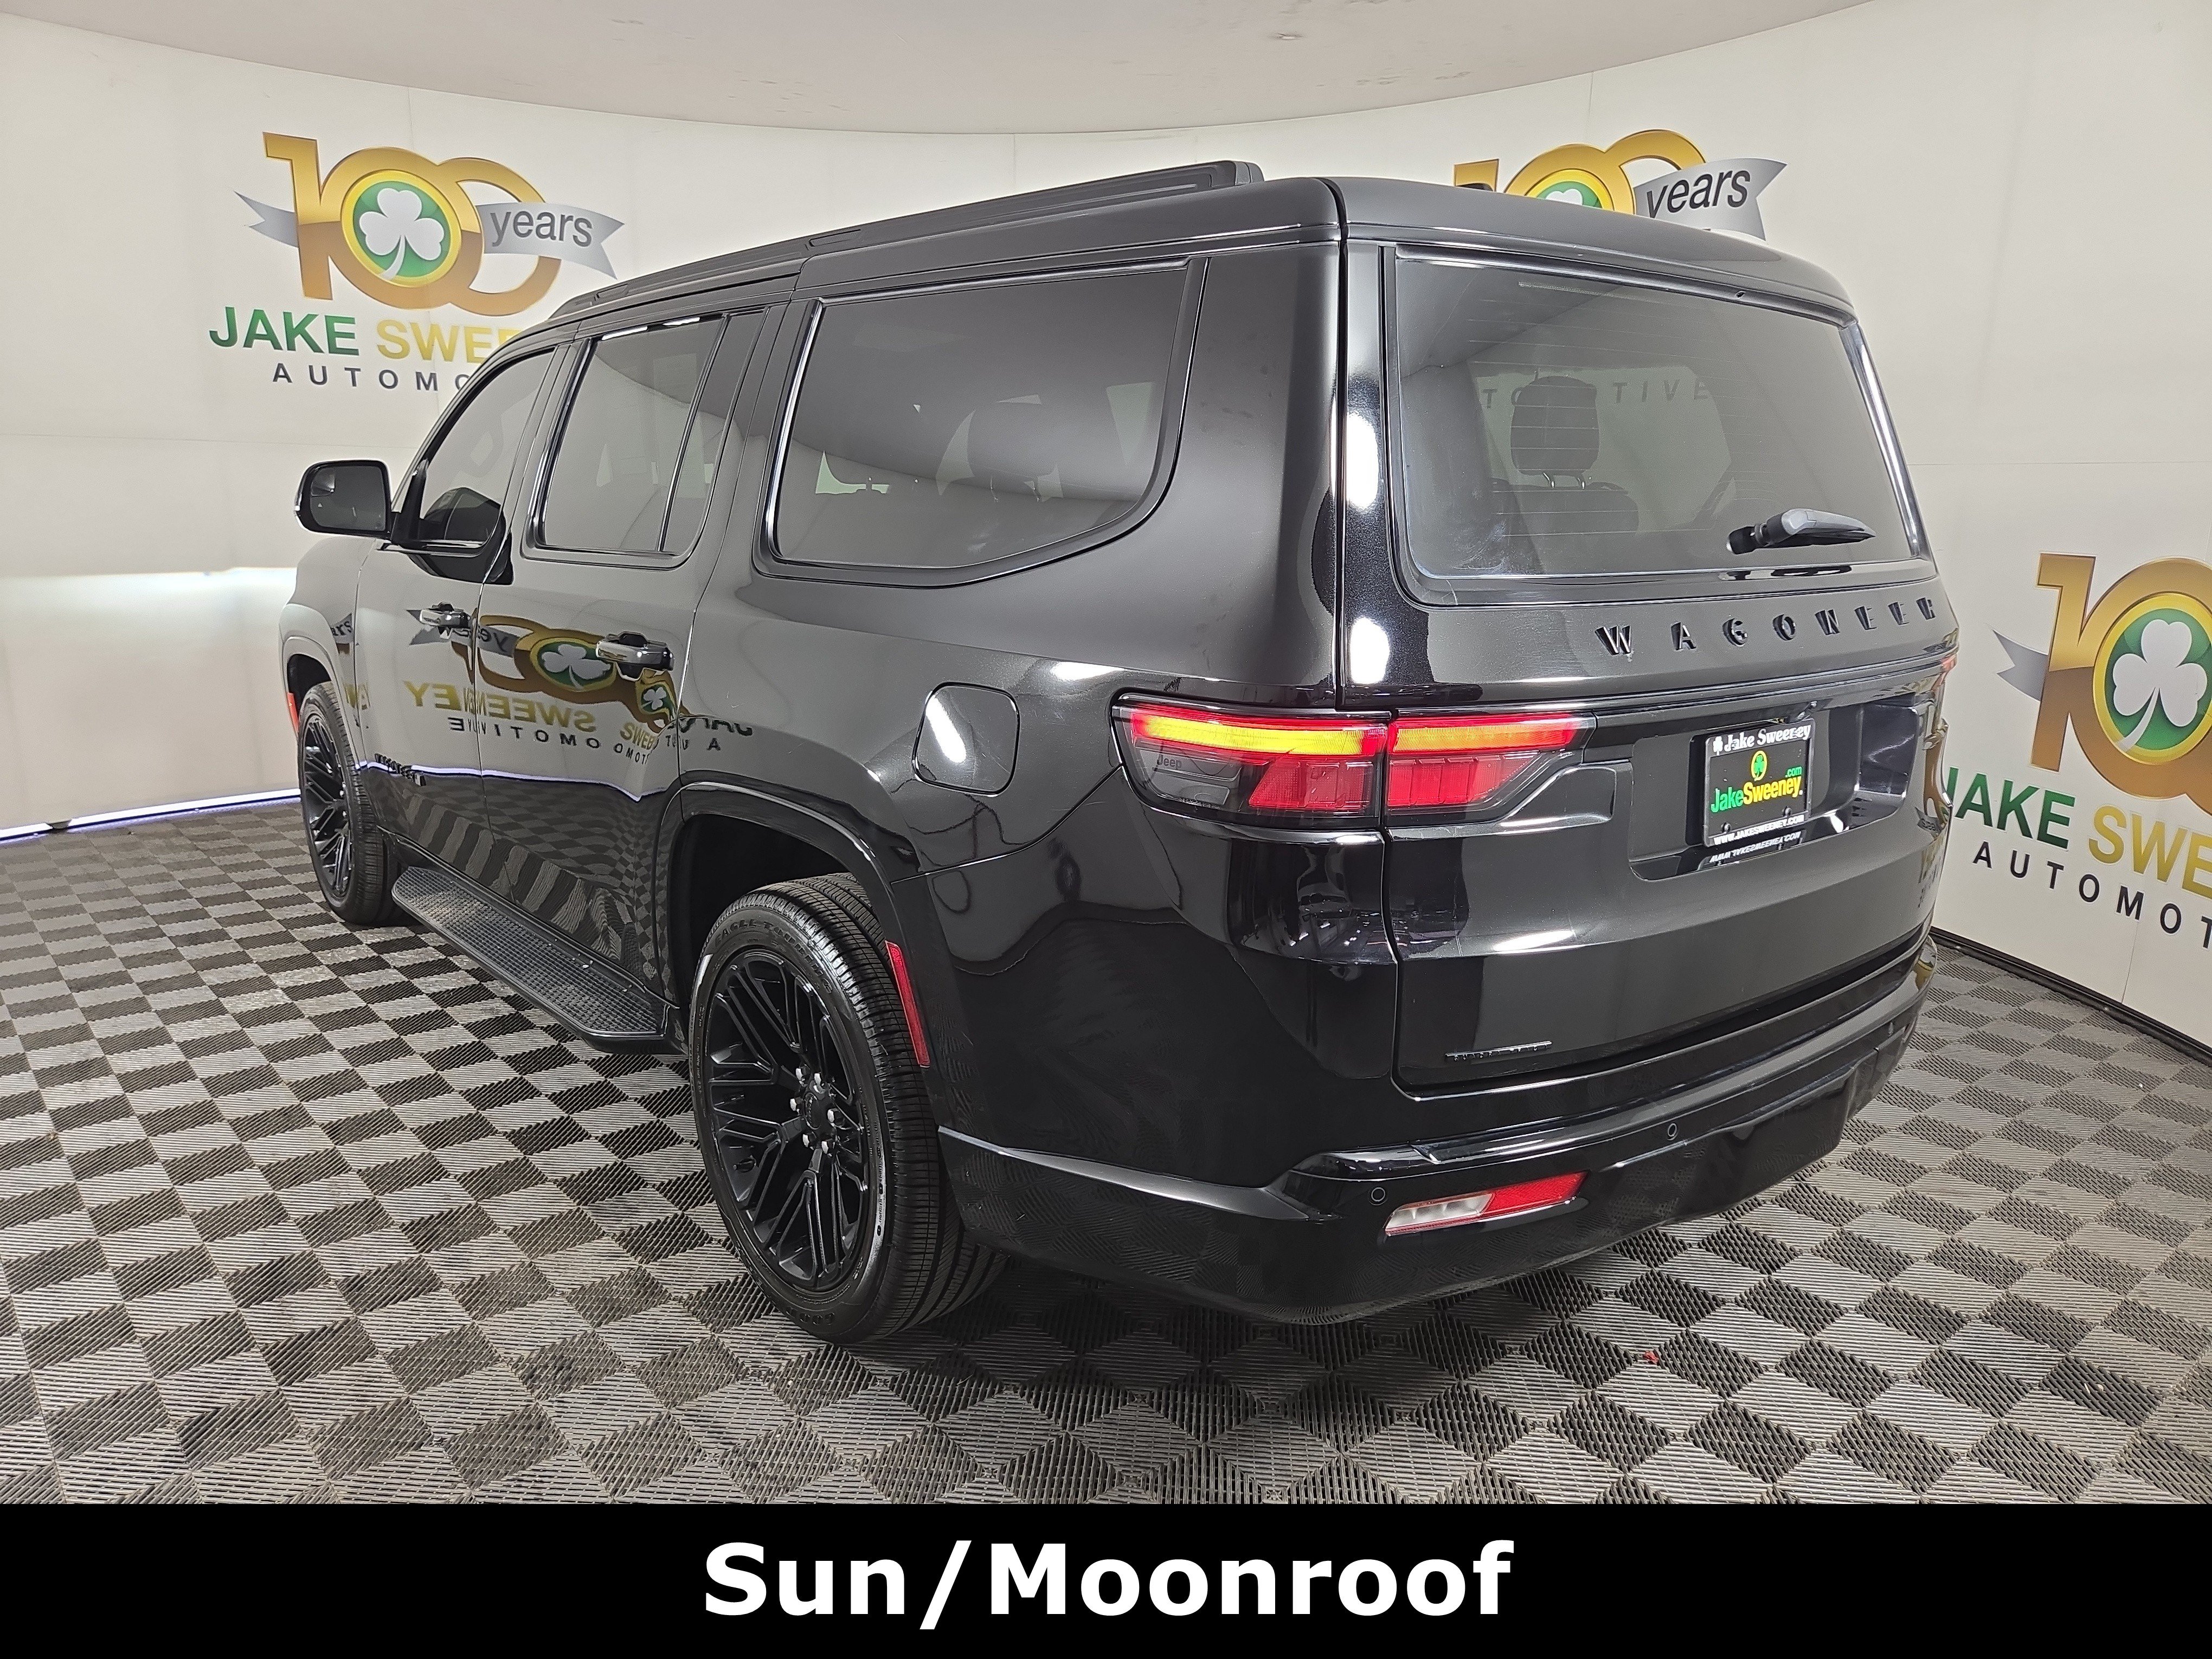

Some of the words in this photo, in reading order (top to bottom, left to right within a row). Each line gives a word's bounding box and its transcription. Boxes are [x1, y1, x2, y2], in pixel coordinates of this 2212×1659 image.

[1646, 170, 1751, 218] years
[262, 132, 561, 316] 100
[490, 210, 593, 248] years
[209, 306, 359, 357] JAKE
[2030, 553, 2212, 813] 10
[1156, 754, 1182, 769] Jeep
[1724, 732, 1755, 752] Jake
